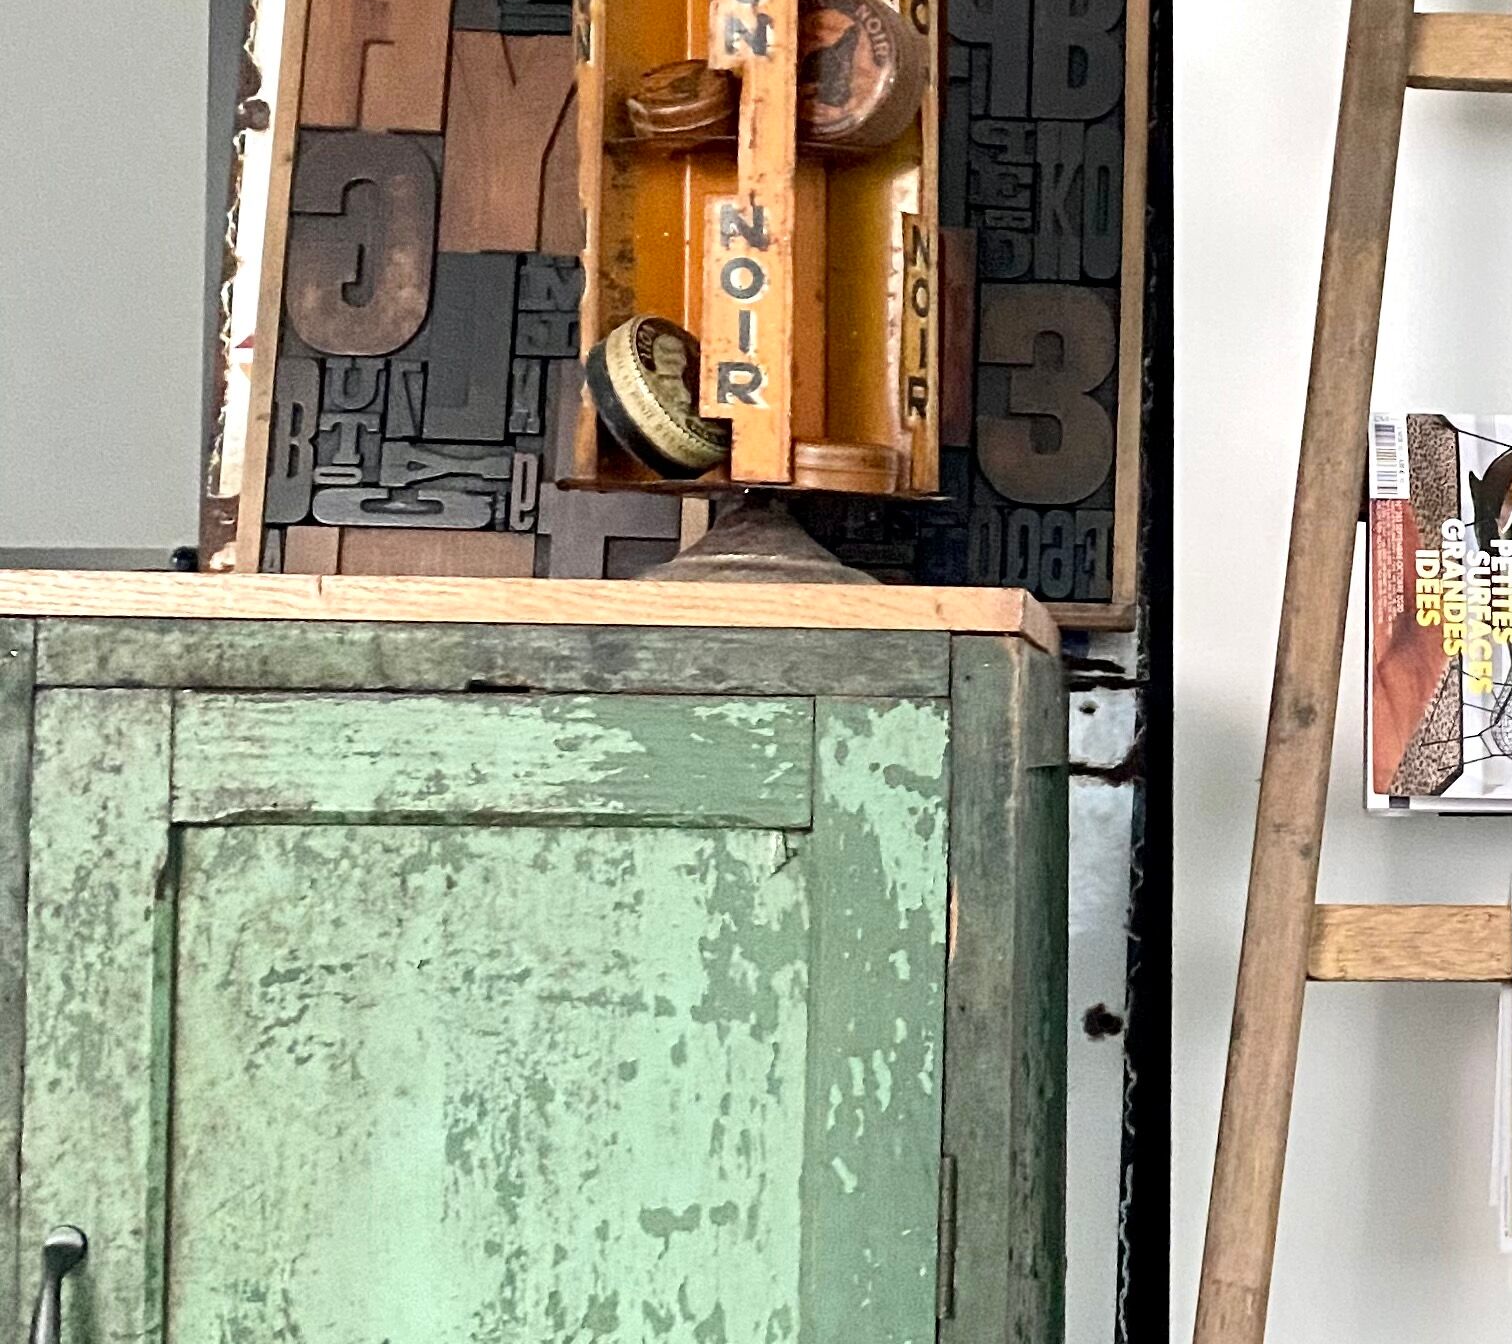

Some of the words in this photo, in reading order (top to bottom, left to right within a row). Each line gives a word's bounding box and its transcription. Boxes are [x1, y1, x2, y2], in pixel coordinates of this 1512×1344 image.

[717, 203, 769, 406] NOIR
[907, 224, 930, 418] NOIR
[1441, 518, 1467, 657] GRANDES
[1466, 550, 1493, 695] SURFACES
